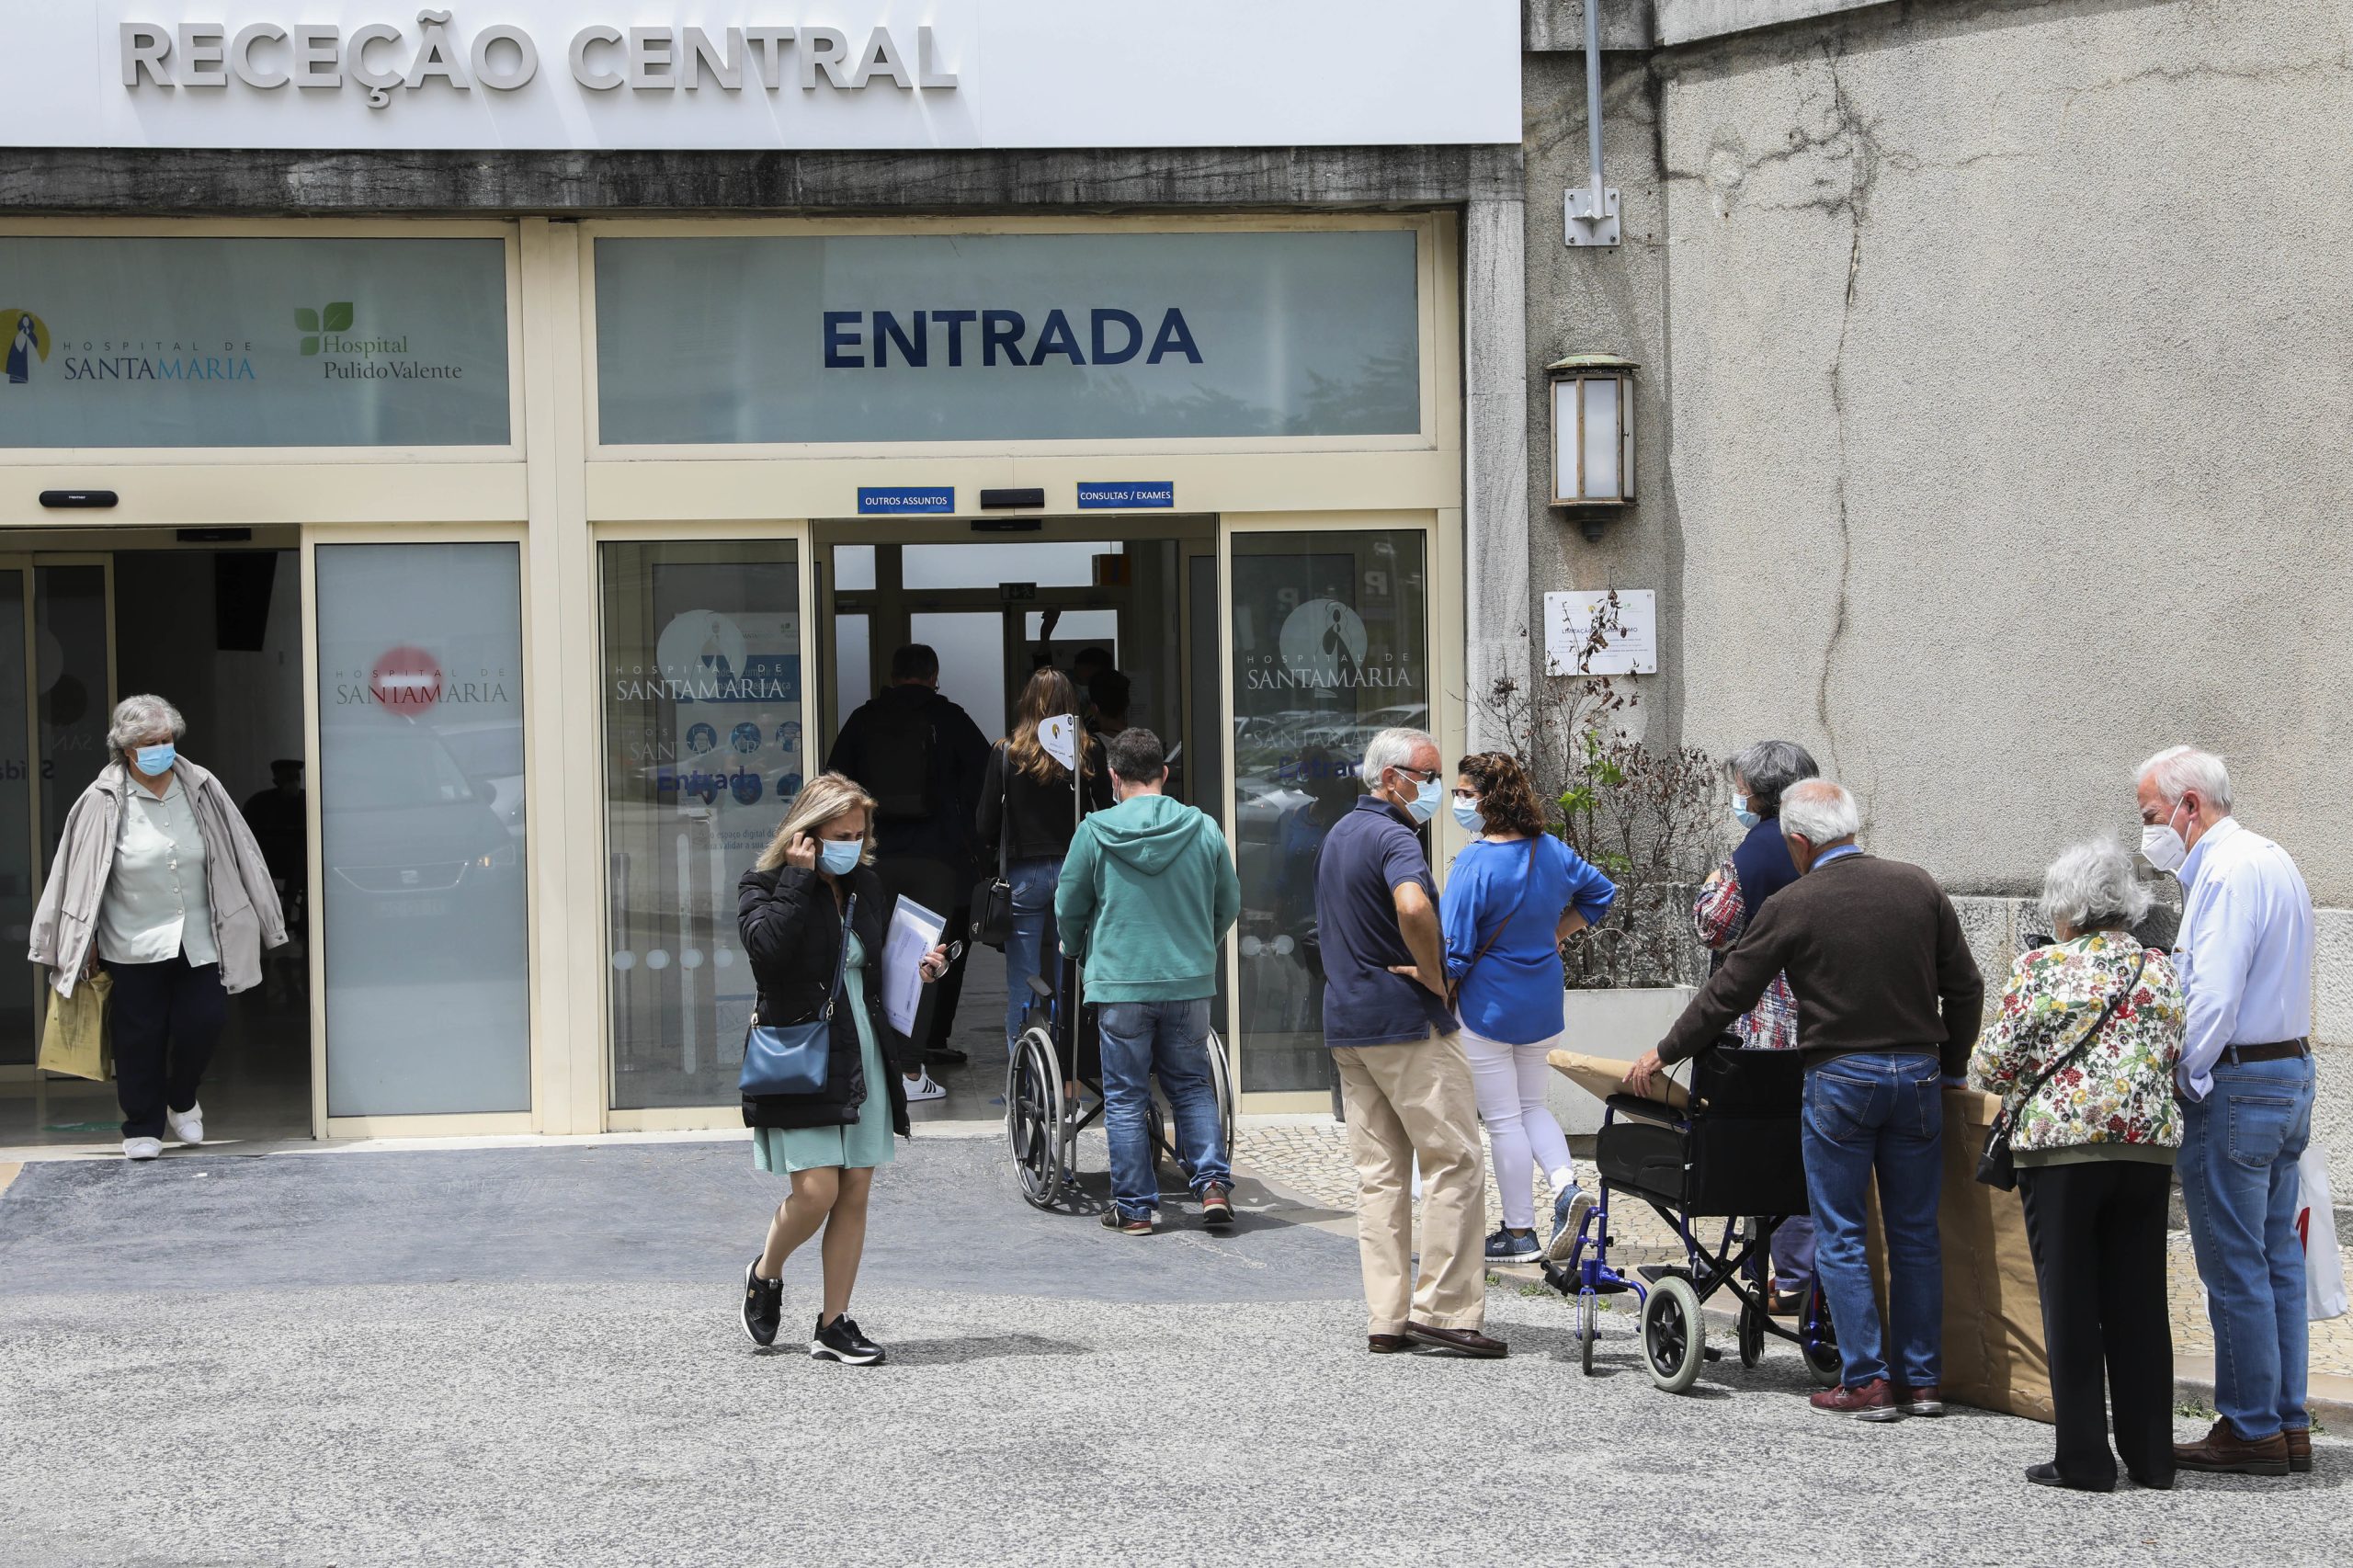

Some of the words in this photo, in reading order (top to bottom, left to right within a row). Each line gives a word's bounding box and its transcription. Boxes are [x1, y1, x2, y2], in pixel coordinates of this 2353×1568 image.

[119, 8, 540, 109] RECEÇÃO
[568, 25, 958, 92] CENTRAL
[63, 341, 199, 351] HOSPITAL
[224, 341, 252, 350] DE
[823, 307, 1202, 369] ENTRADA
[323, 335, 408, 358] Hospital
[64, 357, 256, 381] SANTAMARIA
[865, 497, 901, 506] OUTROS
[903, 496, 948, 506] ASSUNTOS
[1080, 492, 1128, 501] CONSULTAS
[1130, 491, 1135, 501] /
[1136, 491, 1171, 500] EXAMES
[1247, 653, 1363, 664] HOSPITAL
[1385, 653, 1409, 662] DE
[335, 669, 457, 678] HOSPITAL
[481, 668, 505, 676] DE
[616, 665, 734, 675] HOSPITAL
[757, 664, 782, 673] DE
[1247, 667, 1412, 689] SANTAMARIA
[617, 678, 786, 701] SANTAMARIA
